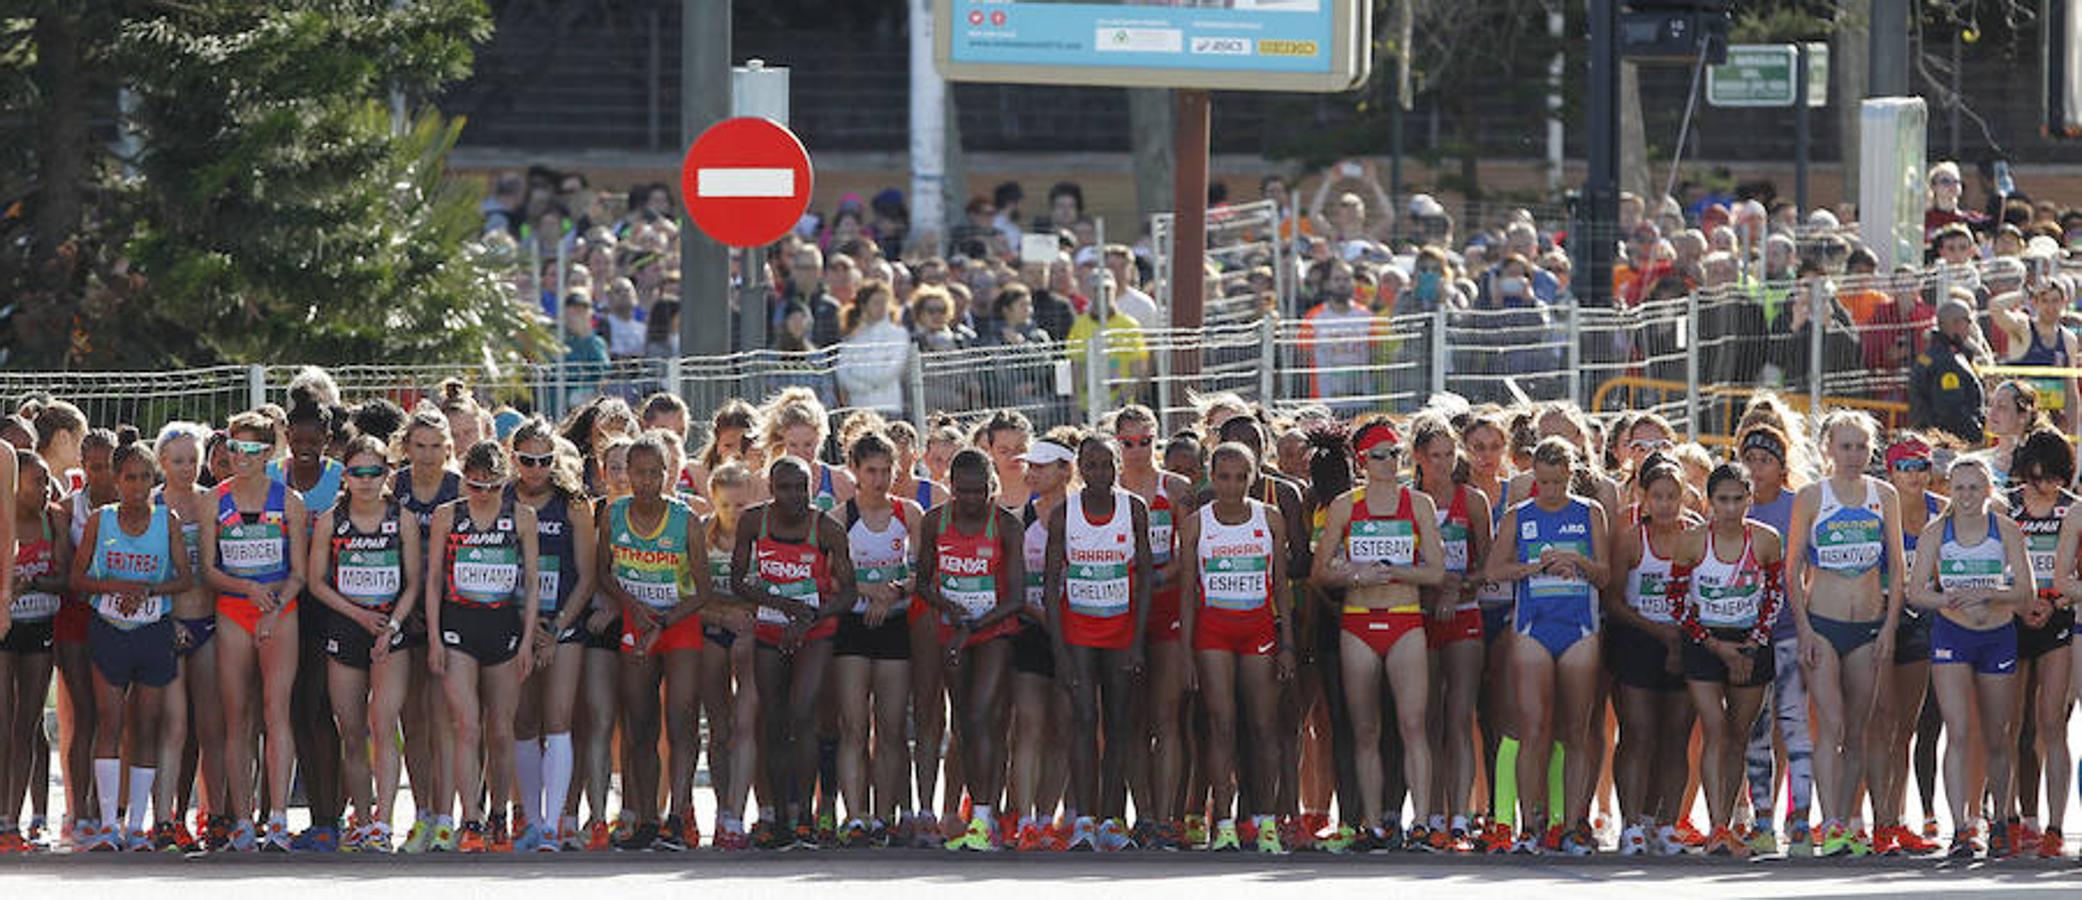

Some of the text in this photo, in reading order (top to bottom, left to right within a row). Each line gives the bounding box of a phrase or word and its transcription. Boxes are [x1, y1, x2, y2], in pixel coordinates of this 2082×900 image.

[536, 521, 562, 534] NCE
[2022, 521, 2060, 533] JAPAN
[346, 537, 389, 550] JAPAN
[462, 532, 505, 545] JAPAN
[1071, 549, 1126, 562] BAHRAIN
[1353, 541, 1411, 556] ESTEBAN
[107, 551, 159, 574] ERITREA
[760, 560, 813, 579] KENYA
[939, 555, 989, 574] KENYA
[342, 570, 397, 589] MORITA
[1208, 576, 1263, 592] ESHETE
[1071, 582, 1127, 600] CHELIMO
[106, 593, 157, 616] TEU
